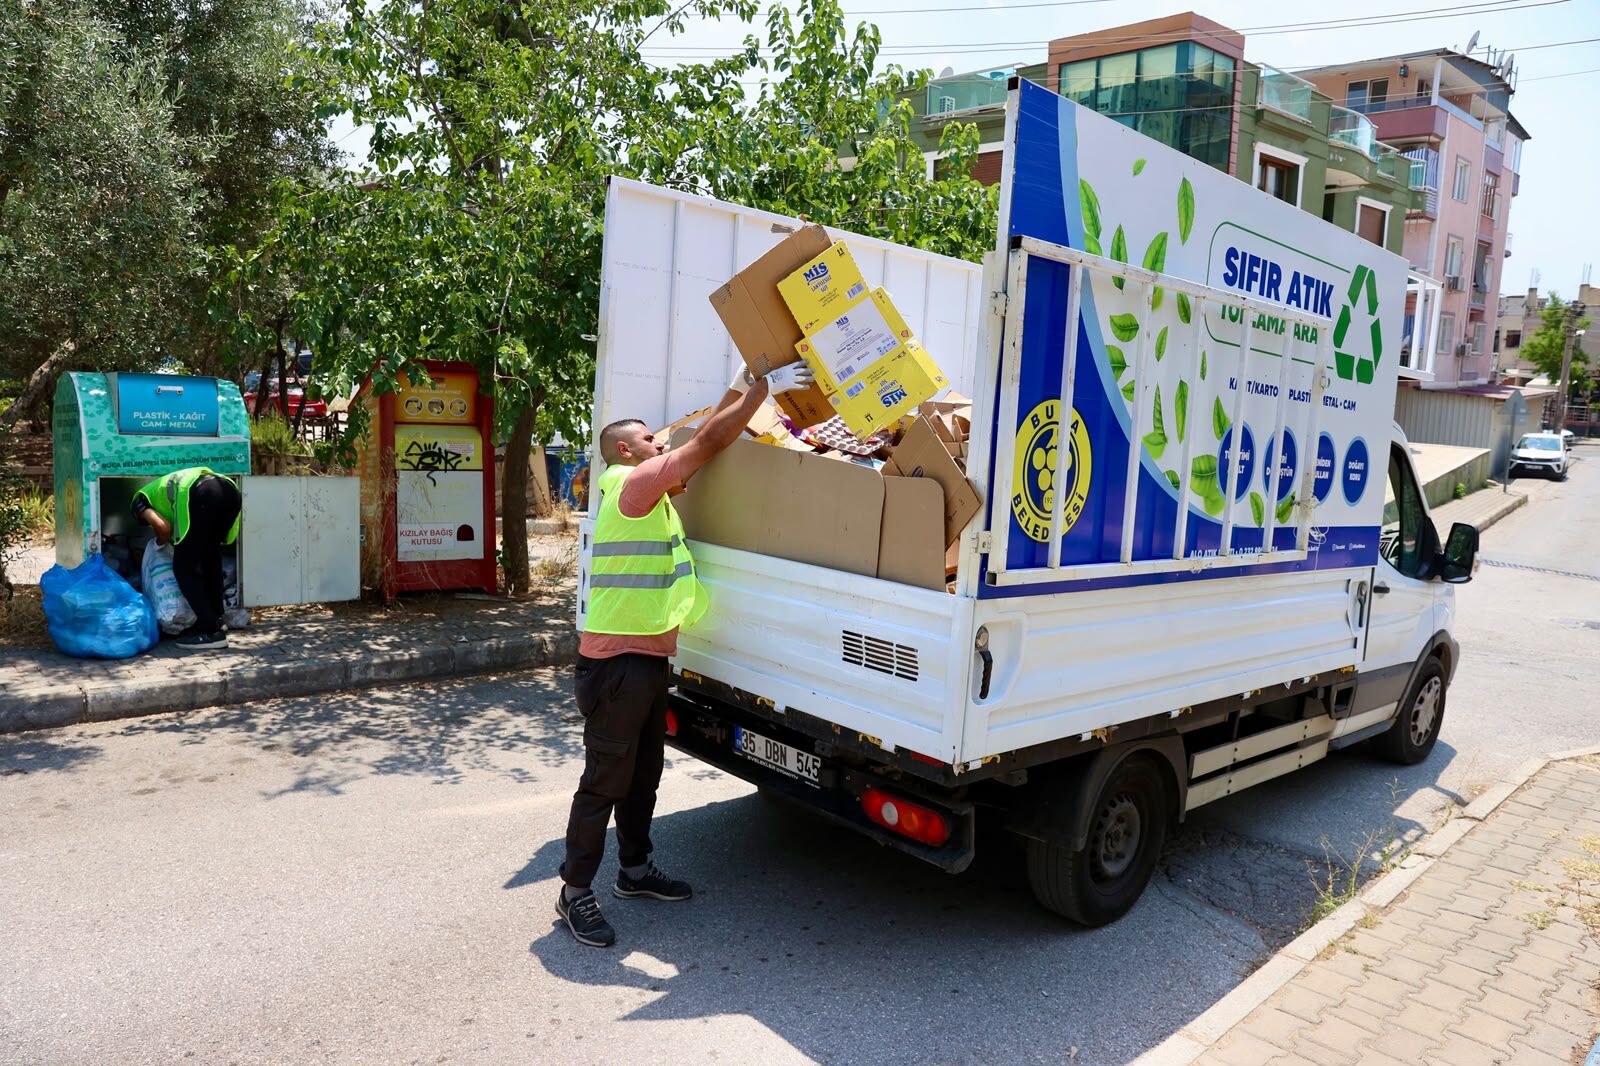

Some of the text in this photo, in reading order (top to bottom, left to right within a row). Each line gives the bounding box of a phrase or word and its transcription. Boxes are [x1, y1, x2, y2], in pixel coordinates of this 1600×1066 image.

[1223, 246, 1335, 318] SIFIR ATIK
[1288, 388, 1311, 403] PLASTİ
[1343, 399, 1357, 411] CAM
[133, 411, 171, 420] PLASTİK
[179, 411, 206, 421] KAĞIT
[169, 421, 197, 429] METAL
[1030, 405, 1079, 435] BUA
[1012, 491, 1085, 540] BELEDESİ
[430, 529, 453, 537] BAĞIŞ
[742, 730, 820, 779] 35 DBN 545
